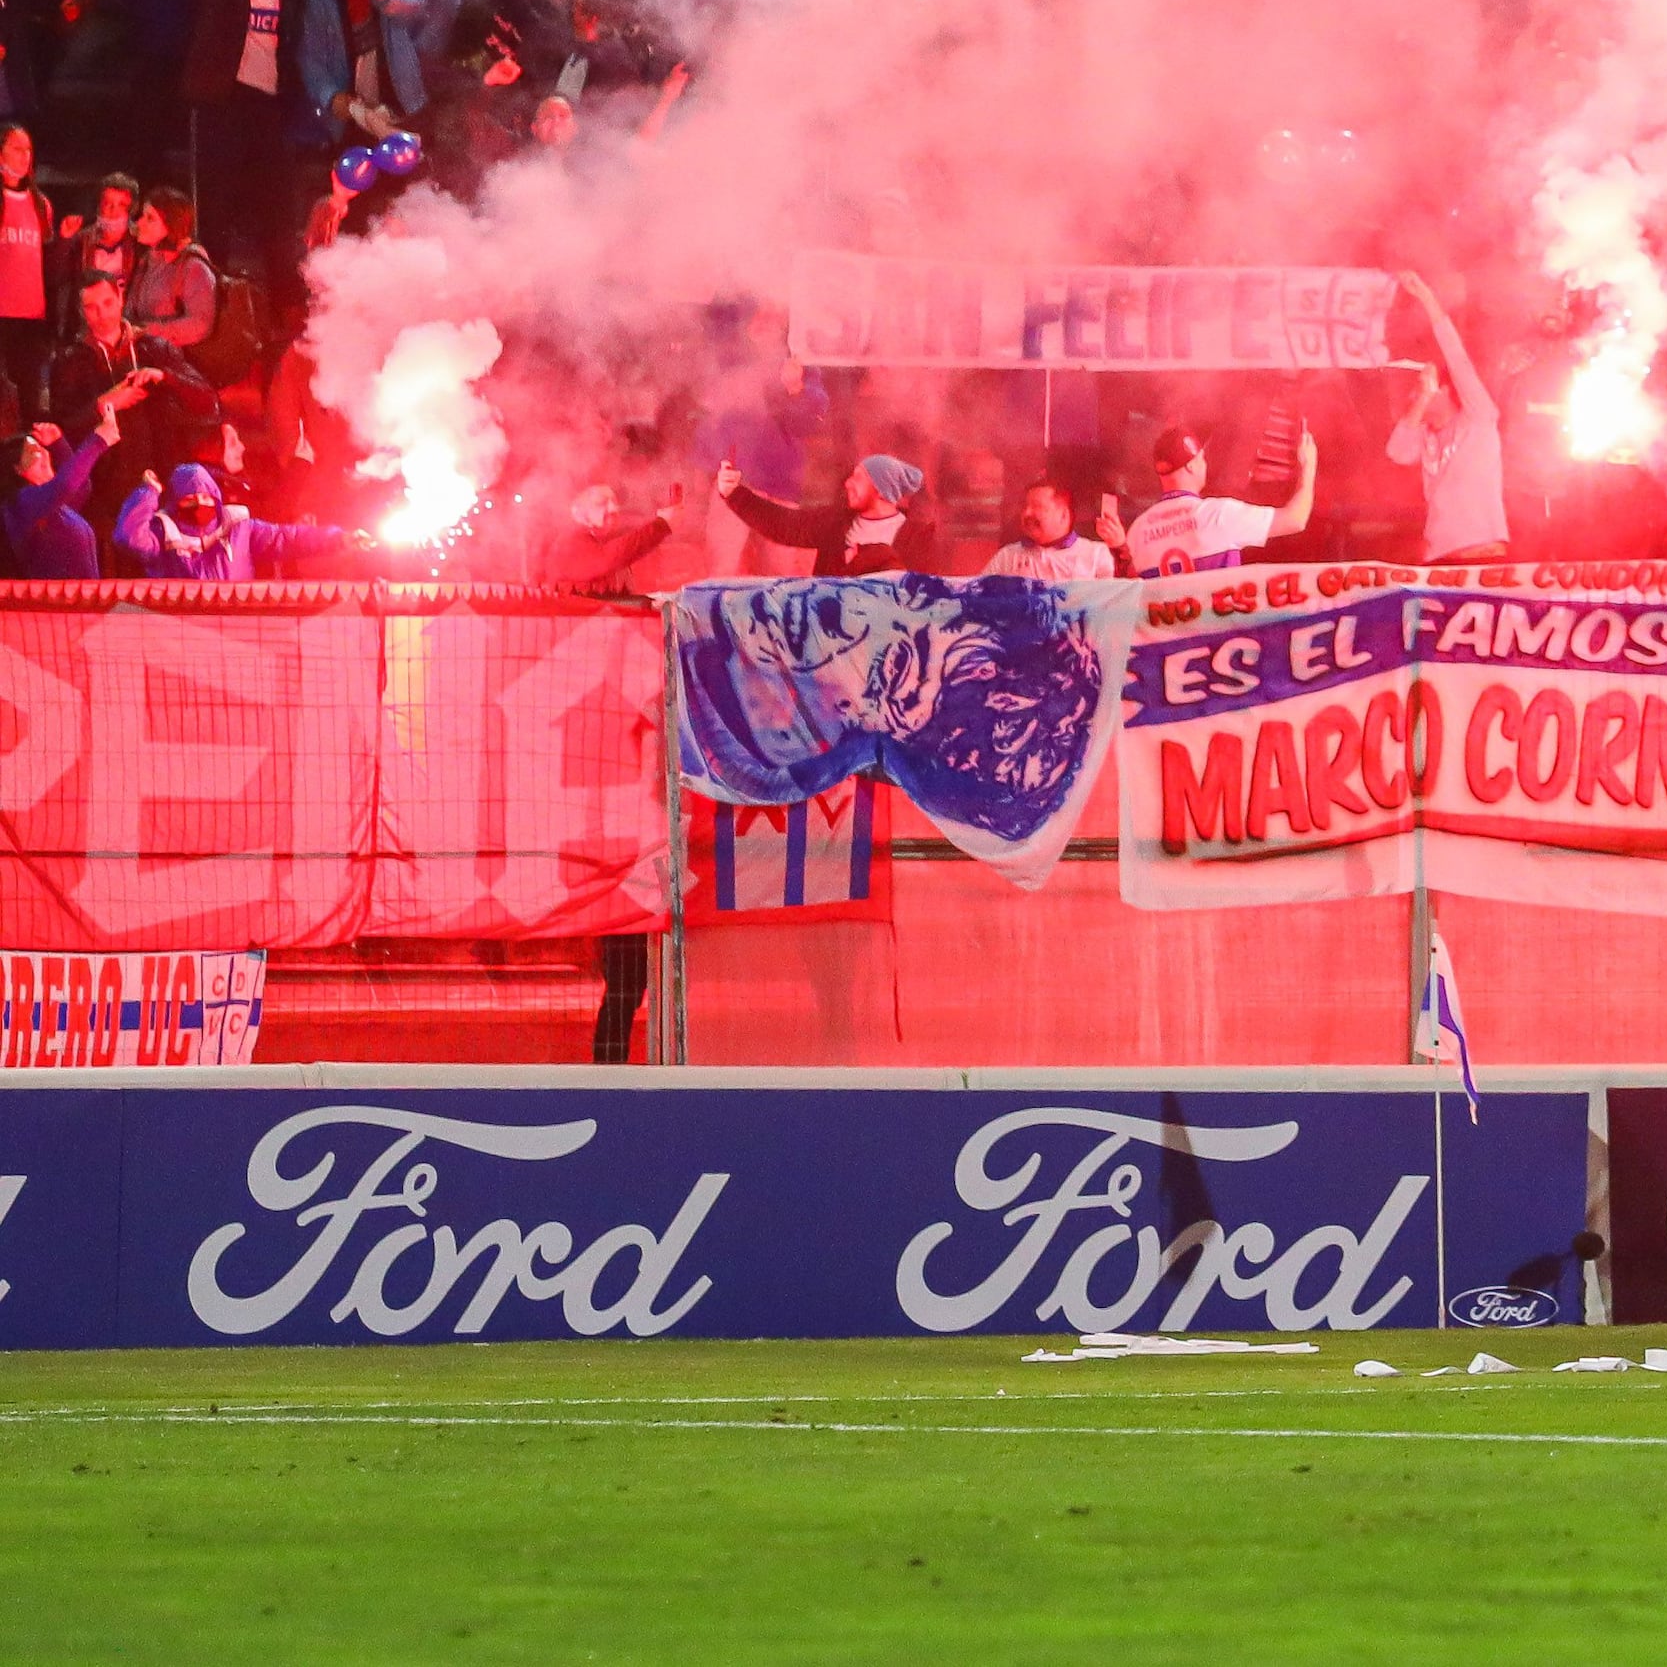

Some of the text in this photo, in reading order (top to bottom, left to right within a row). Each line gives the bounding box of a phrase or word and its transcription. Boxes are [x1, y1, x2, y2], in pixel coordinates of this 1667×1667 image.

[1021, 271, 1274, 360] FELIPE
[1148, 599, 1201, 627] NO
[1212, 582, 1257, 616] ES
[1266, 575, 1308, 610] EL
[1470, 565, 1522, 587] EL
[1163, 638, 1262, 706] ES
[1288, 614, 1373, 682] EL
[1160, 679, 1443, 855] MARCO
[0, 956, 123, 1067] RERO
[187, 1105, 730, 1336] Ford
[896, 1107, 1431, 1332] Ford
[1470, 1291, 1539, 1325] Ford
